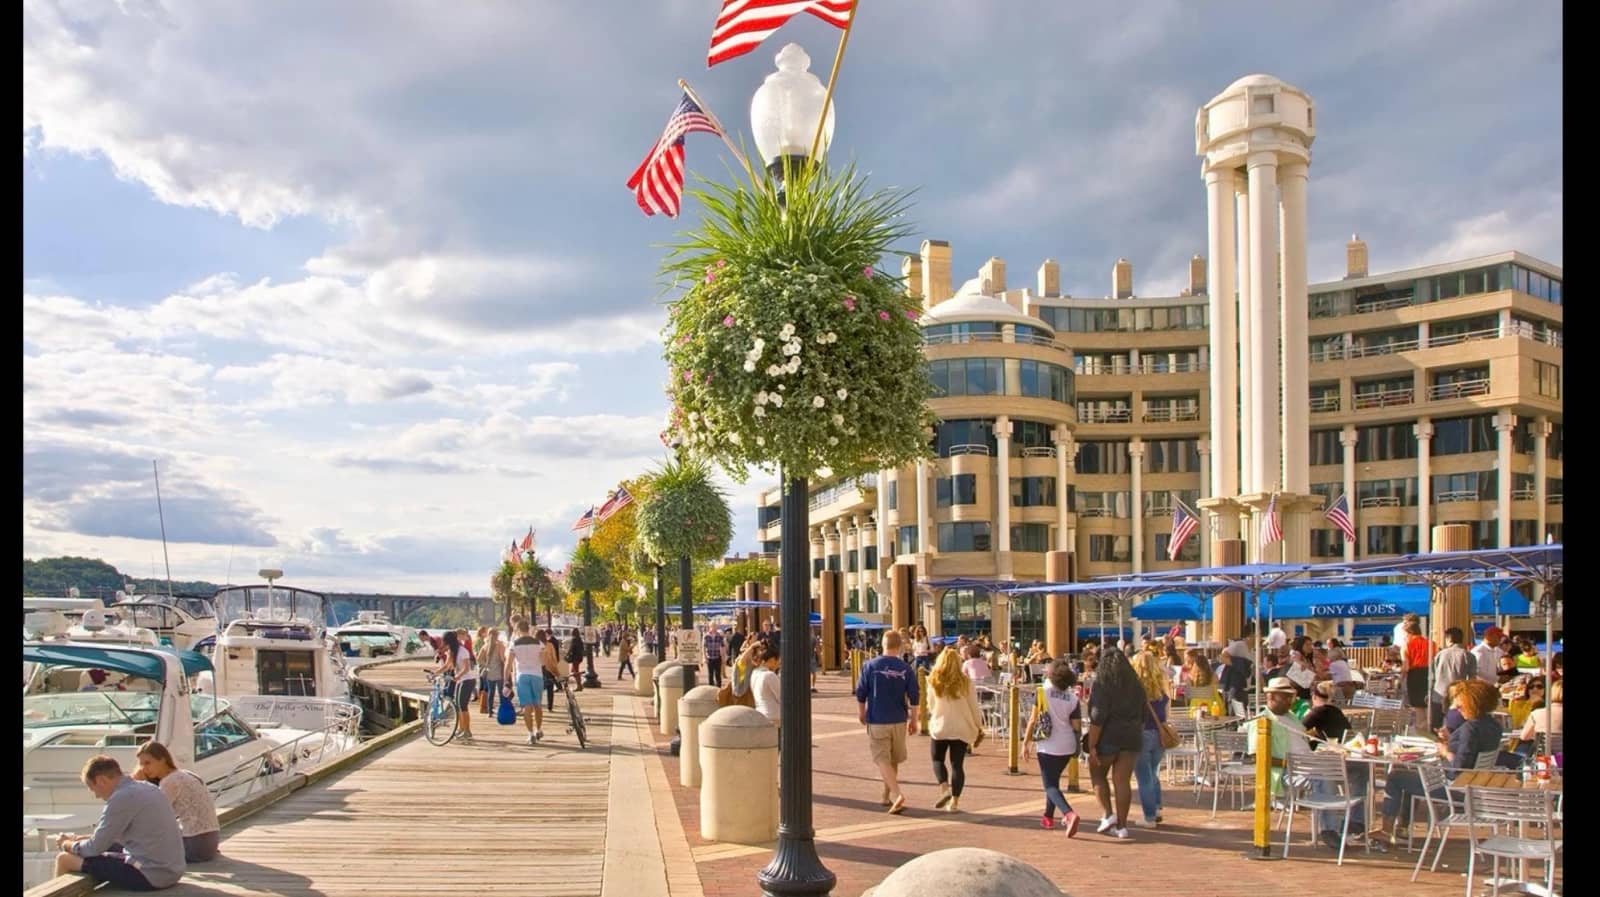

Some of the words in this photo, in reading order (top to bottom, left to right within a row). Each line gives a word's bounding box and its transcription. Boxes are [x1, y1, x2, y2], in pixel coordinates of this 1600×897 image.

[1309, 605, 1344, 615] TONY
[1347, 605, 1358, 615] &
[1361, 603, 1396, 615] JOE'S
